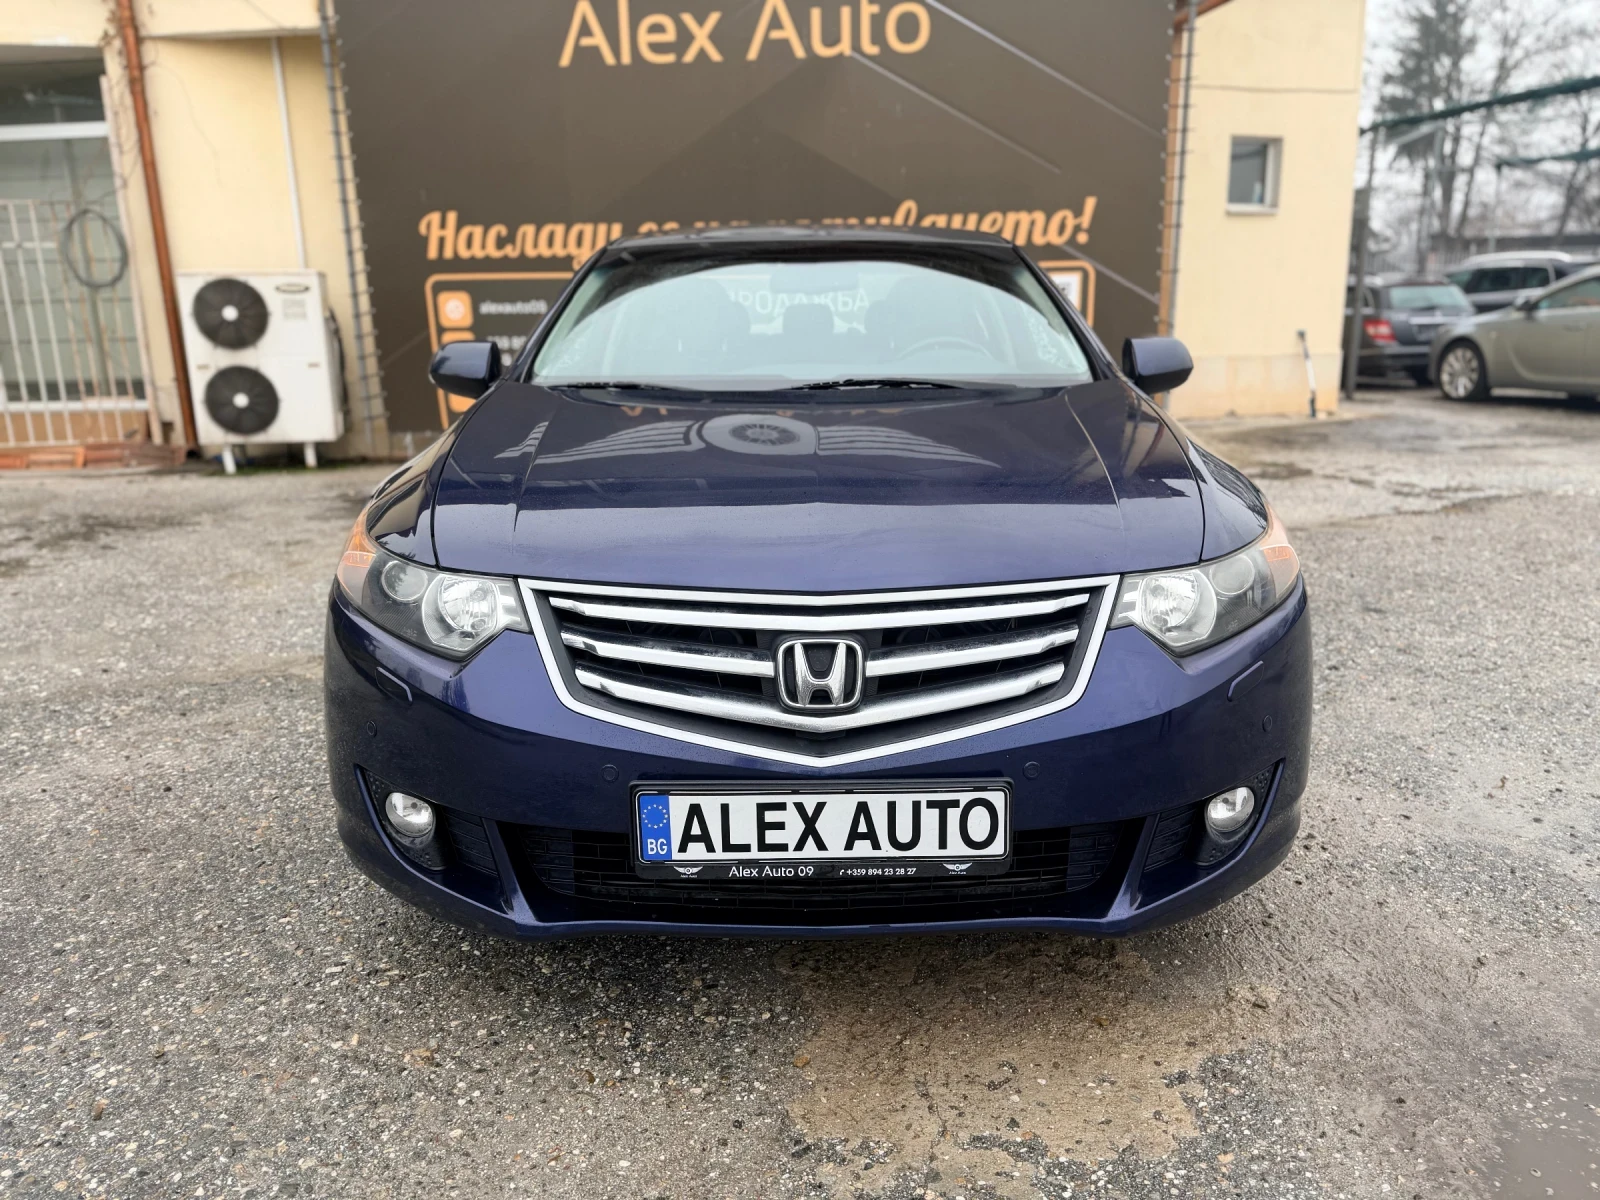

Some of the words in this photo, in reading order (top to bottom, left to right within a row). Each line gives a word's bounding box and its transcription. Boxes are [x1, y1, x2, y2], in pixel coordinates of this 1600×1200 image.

[558, 0, 723, 68] Alex
[745, 0, 931, 62] Auto
[647, 838, 668, 855] BG
[677, 801, 829, 854] ALEX
[843, 797, 999, 852] AUTO
[728, 865, 759, 878] Alex
[761, 865, 795, 877] Auto
[797, 866, 814, 877] 09
[846, 868, 867, 876] +359
[867, 868, 882, 876] 894
[883, 868, 894, 876] 23
[895, 867, 905, 875] 28
[906, 867, 917, 875] 27
